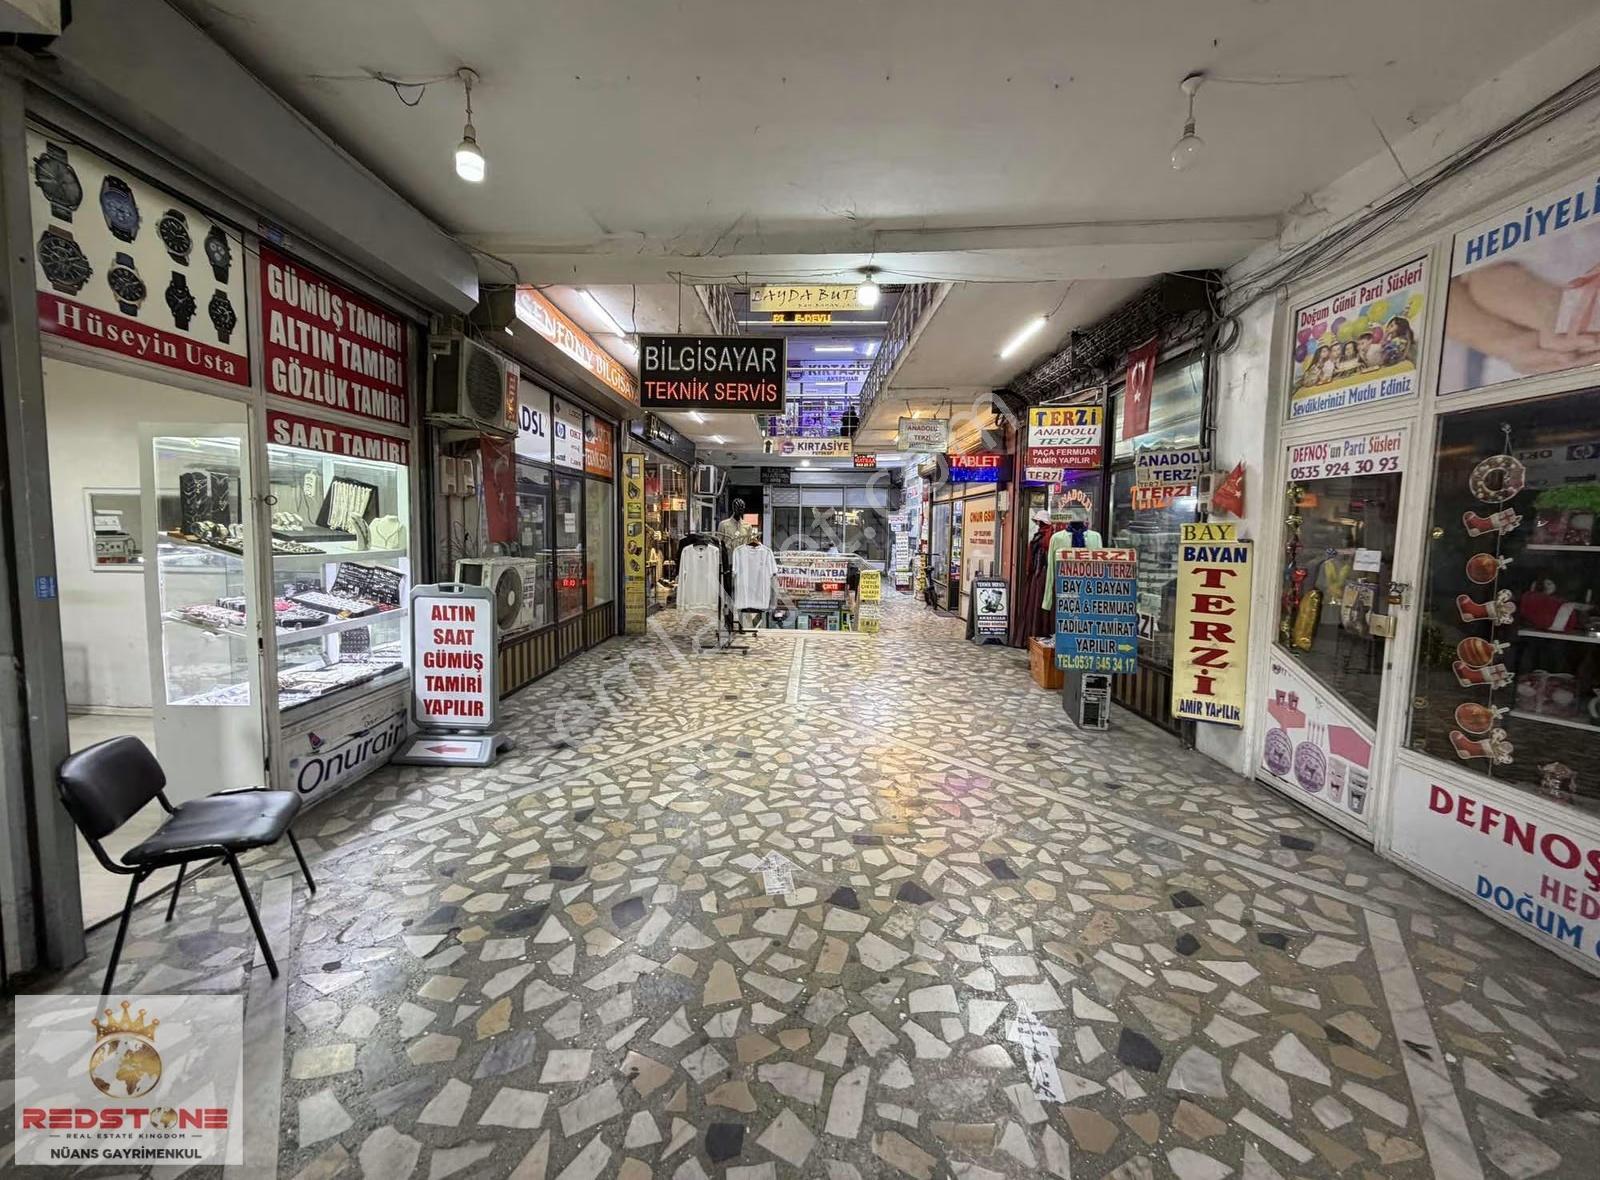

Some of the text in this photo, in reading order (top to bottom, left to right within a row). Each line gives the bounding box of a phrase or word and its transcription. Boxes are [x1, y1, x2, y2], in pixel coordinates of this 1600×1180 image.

[1301, 264, 1423, 327] Doğum Günü Parti Süsleri
[267, 263, 402, 353] GÜMÜŞ TAMİRİ
[56, 301, 236, 376] Hüseyin Usta
[270, 311, 402, 387] ALTIN TAMİRİ
[645, 340, 776, 373] BİLGİSAYAR
[808, 361, 874, 376] KIRTASİY
[272, 357, 403, 423] GÖZLÜK TAMİRİ
[645, 378, 777, 402] TEKNİK SERVİS
[1292, 377, 1411, 417] Sevdiklerinizi Mutlu Ediniz
[1036, 409, 1096, 426] TERZİ
[274, 419, 407, 464] SAAT TAMİRİ
[797, 440, 849, 451] KIRTASİYE
[1344, 437, 1365, 456] Parti
[1368, 431, 1401, 453] Süsleri
[950, 456, 1000, 467] TABLET
[1138, 452, 1210, 467] ANADOLU
[1291, 457, 1398, 480] 0535 924 30 93
[1139, 483, 1192, 498] TERZİ
[1184, 525, 1231, 540] BAY
[1060, 550, 1135, 561] TERZİ
[1184, 546, 1247, 564] BAYAN
[811, 569, 845, 577] MATBA
[1060, 562, 1104, 577] ANADOLU
[1063, 580, 1130, 595] BAY & BAYAN
[431, 605, 475, 622] ALTIN
[1059, 599, 1135, 616] PAÇA & FERMUAR
[1058, 617, 1134, 637] TADİLAT TAMİRAT
[1189, 567, 1237, 696] TERZİ
[433, 628, 474, 645] SAAT
[1076, 639, 1116, 653] YAPILIR
[424, 650, 484, 673] GÜMÜŞ
[425, 674, 482, 693] TAMİRİ
[423, 699, 484, 717] YAPILIR
[298, 723, 404, 794] Onurair
[1476, 875, 1584, 949] DOĞUM
